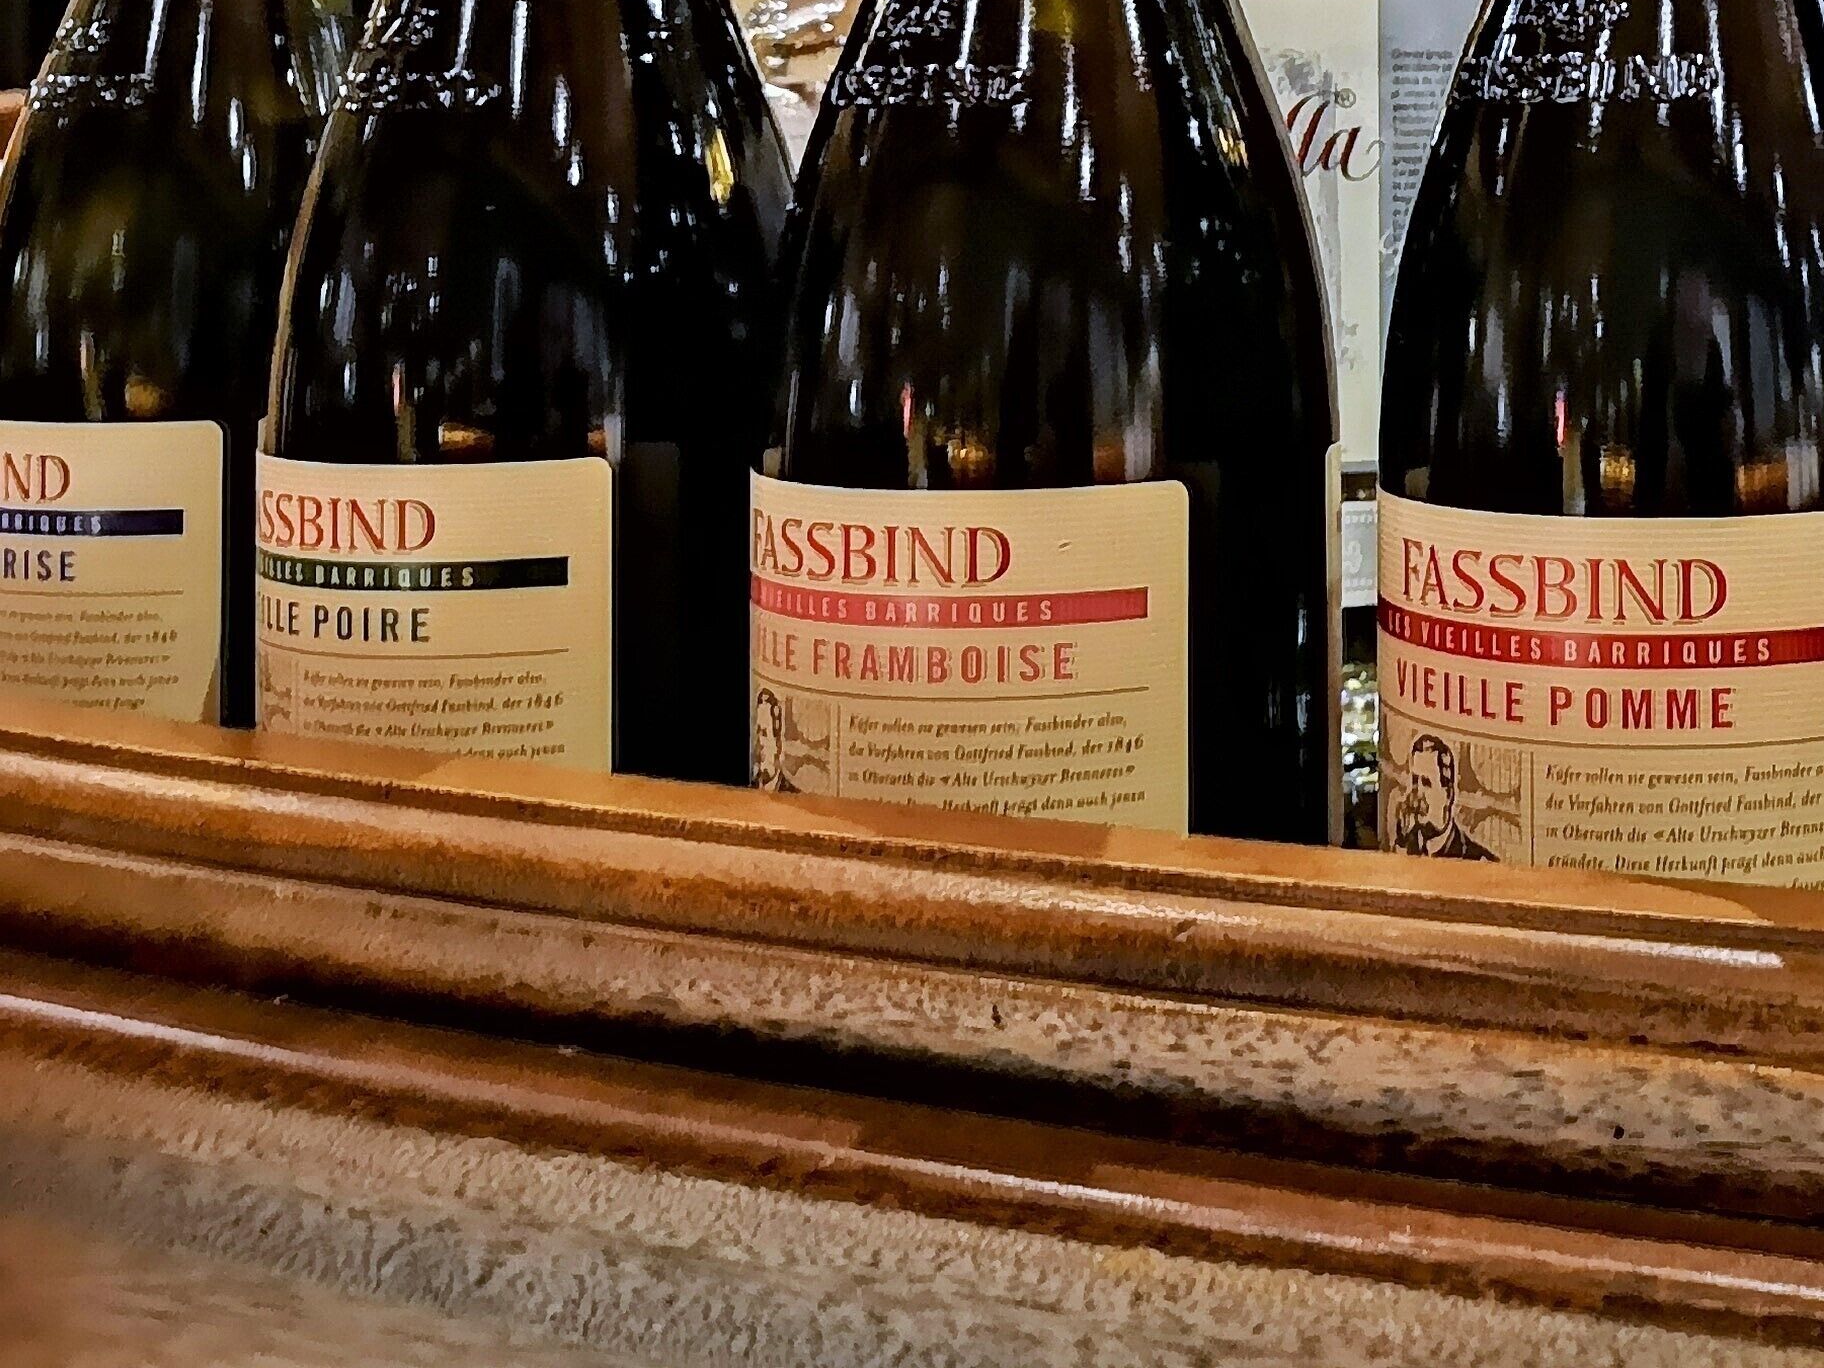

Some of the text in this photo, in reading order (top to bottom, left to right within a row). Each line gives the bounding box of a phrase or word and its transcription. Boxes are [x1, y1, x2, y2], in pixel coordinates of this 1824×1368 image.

[753, 507, 1012, 588] FASSBIND
[1402, 537, 1727, 625] FASSBIND
[313, 603, 431, 643] POIRE
[865, 599, 1052, 625] BARRIQUES
[812, 637, 1078, 684] FRAMBOISE
[1420, 618, 1541, 661] VIEILLES
[1565, 638, 1771, 664] BARRIQUES
[1397, 657, 1735, 730] VIEILLE POMME
